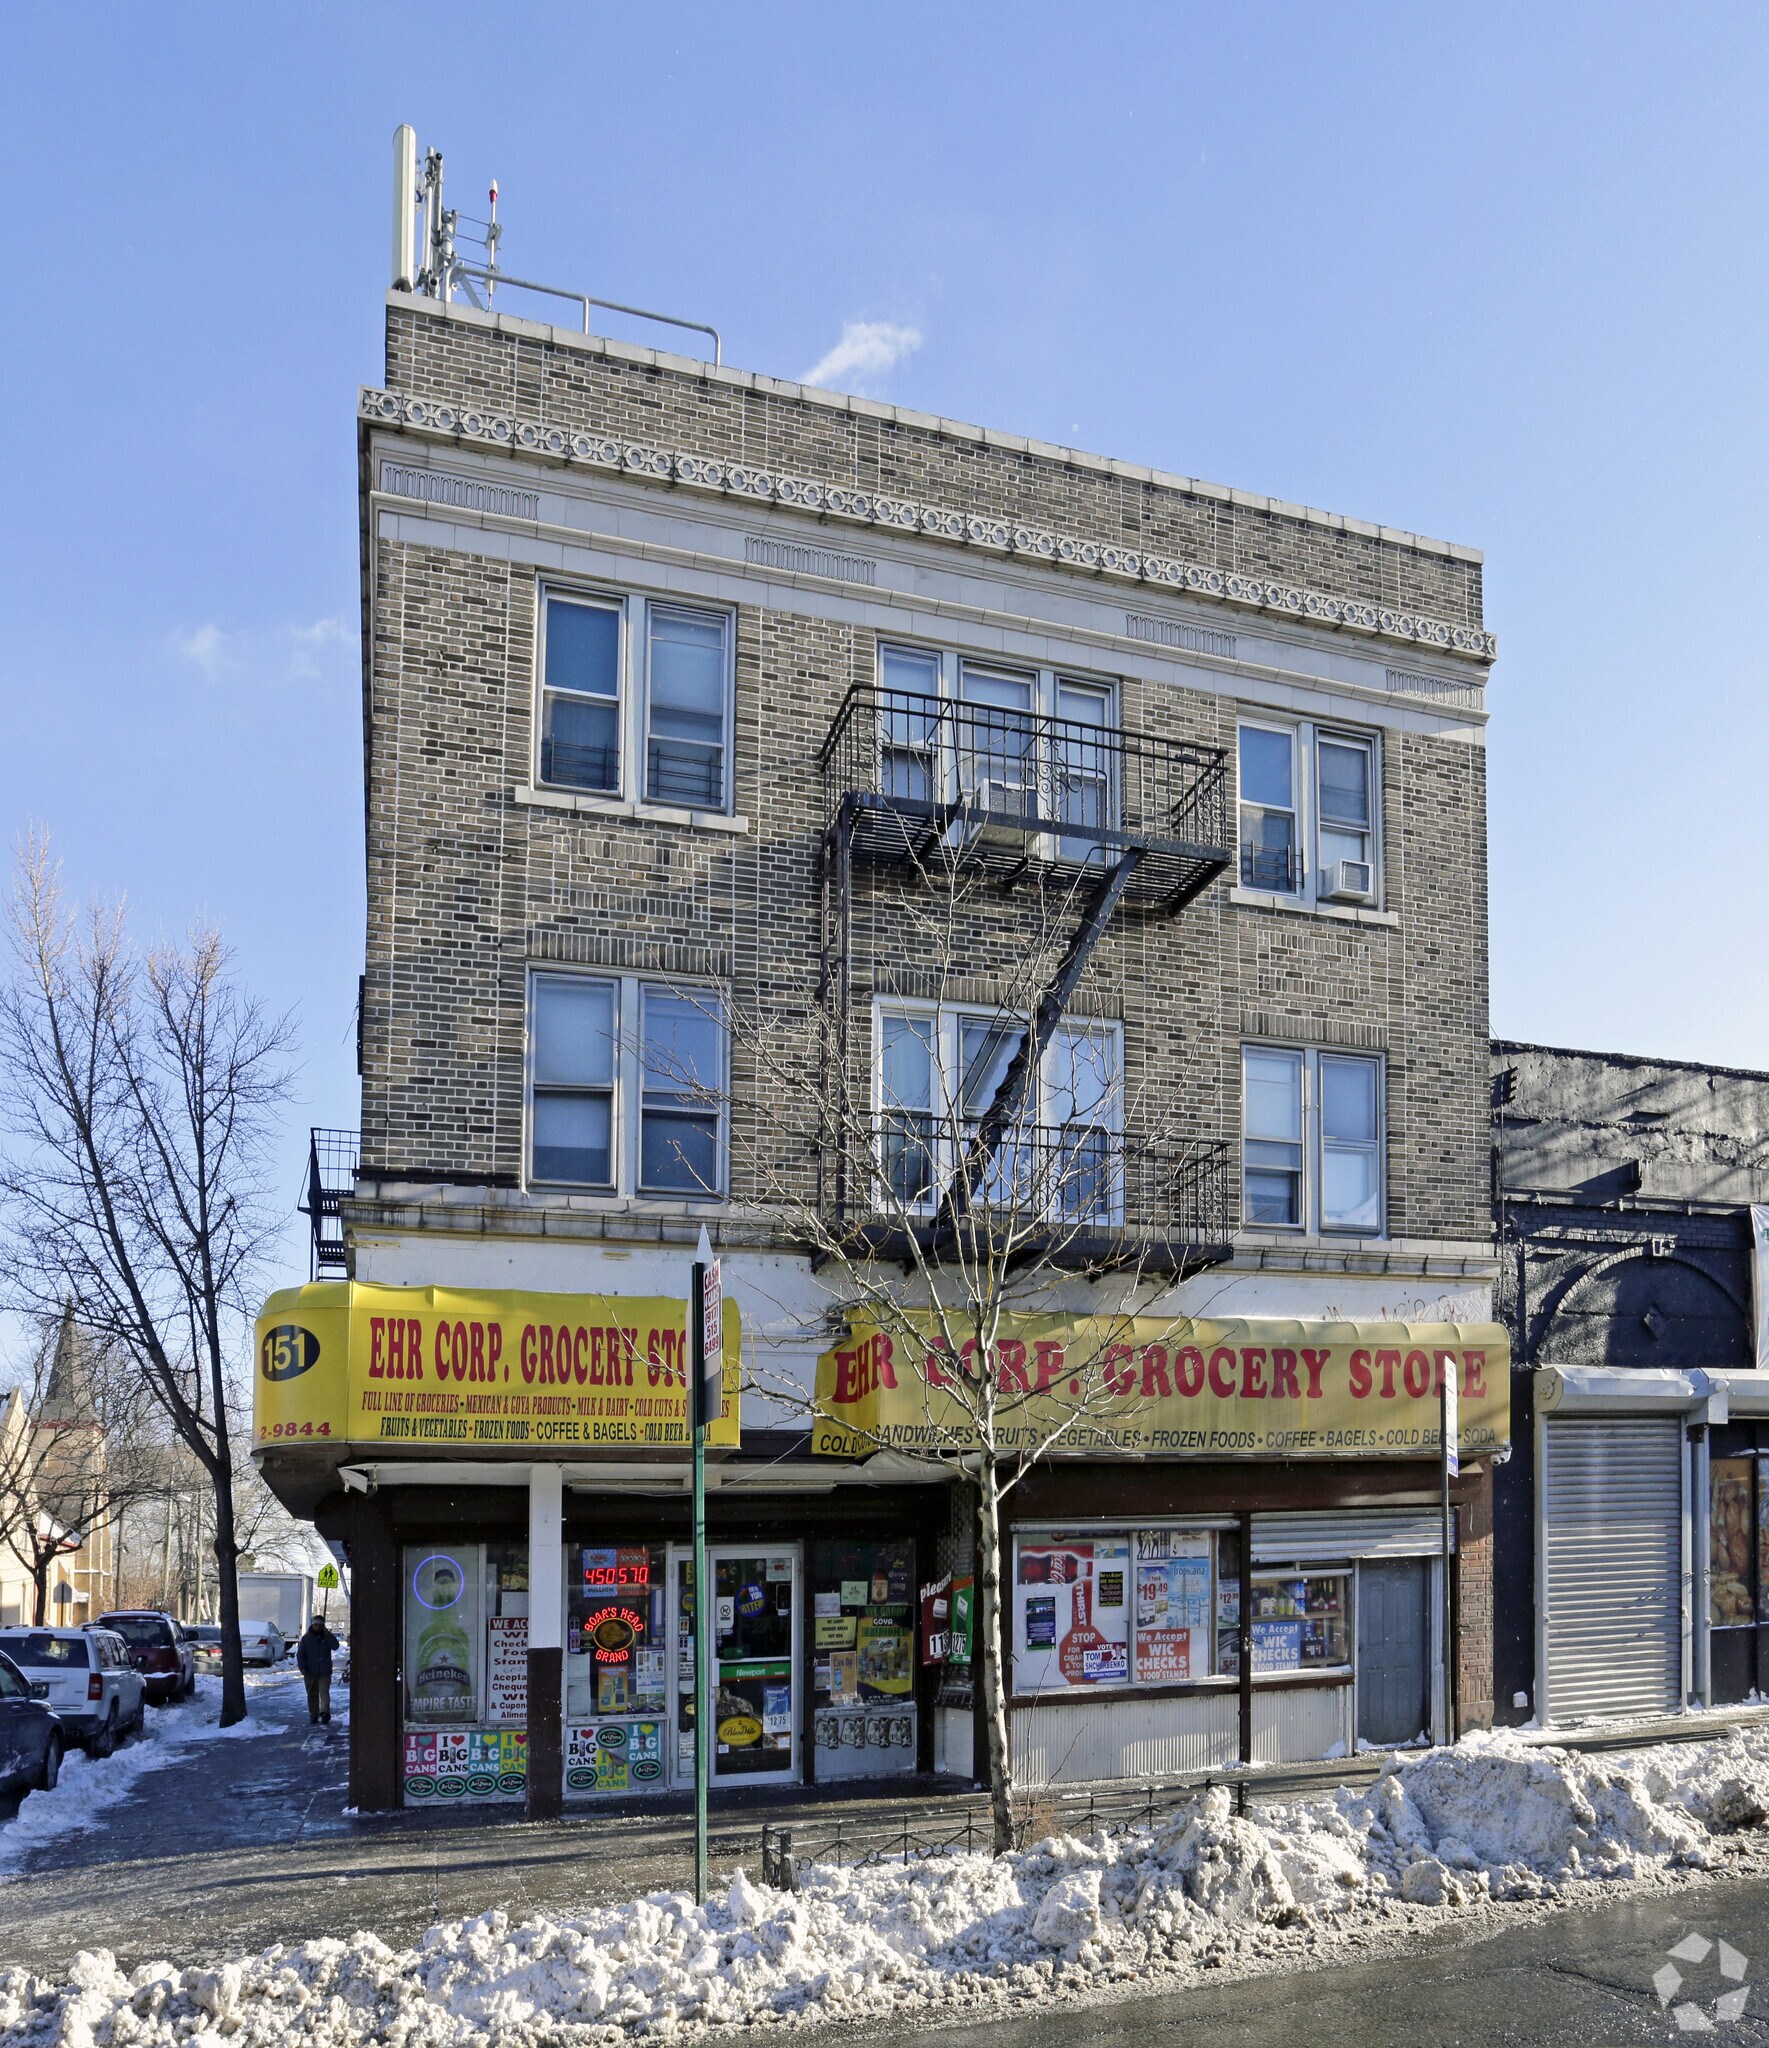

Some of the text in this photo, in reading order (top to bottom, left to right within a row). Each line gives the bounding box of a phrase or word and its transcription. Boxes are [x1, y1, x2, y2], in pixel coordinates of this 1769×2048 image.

[707, 1321, 717, 1339] 515
[265, 1333, 305, 1371] 151
[369, 1317, 422, 1380] EHR
[435, 1320, 509, 1383] CORP.
[521, 1323, 637, 1386] GROCERY
[705, 1335, 718, 1356] 6499
[831, 1333, 898, 1403] EHR
[1103, 1343, 1331, 1399] GROCERY
[362, 1391, 381, 1410] FULL
[384, 1393, 402, 1411] LINE
[404, 1394, 413, 1412] OF
[416, 1394, 458, 1413] GROCERIES
[466, 1395, 502, 1414] MEXICAN
[503, 1397, 508, 1414] &
[510, 1397, 530, 1414] GOYA
[532, 1397, 570, 1416] PRODUCTS
[577, 1399, 597, 1416] MILK
[599, 1399, 604, 1416] &
[606, 1399, 629, 1416] DAIRY
[634, 1400, 653, 1417] COLD
[654, 1400, 672, 1417] CUTS
[674, 1400, 680, 1417] &
[381, 1417, 409, 1437] FRUITS
[412, 1418, 418, 1437] &
[420, 1418, 467, 1438] VEGETABLES
[473, 1420, 504, 1439] FROZEN
[506, 1420, 530, 1440] FOODS
[536, 1422, 579, 1440] COFFEE
[583, 1422, 590, 1440] &
[593, 1422, 636, 1440] BAGELS
[644, 1423, 662, 1441] COLD
[664, 1423, 683, 1441] BEER
[992, 1426, 1037, 1445] RUITS
[1152, 1430, 1206, 1448] FROZEN
[1210, 1431, 1255, 1448] FOODS
[1266, 1431, 1316, 1447] COFFEE
[1326, 1430, 1376, 1446] BAGELS
[1387, 1429, 1418, 1445] COLD
[1464, 1429, 1495, 1444] SODA
[585, 1568, 616, 1584] 450
[618, 1567, 648, 1583] 570
[1173, 1564, 1206, 1577] Tropicana
[493, 1620, 509, 1629] WE
[584, 1607, 644, 1632] BOAR'S HEAD
[873, 1618, 893, 1626] GOYA
[1251, 1624, 1298, 1635] We Accept
[1072, 1633, 1095, 1643] STOP
[1138, 1632, 1187, 1642] We Accept
[1263, 1636, 1287, 1648] WIC
[596, 1649, 629, 1663] GRAND
[1149, 1643, 1174, 1656] WIC
[1251, 1648, 1299, 1661] CHECKS
[1085, 1653, 1100, 1661] TOM
[1137, 1656, 1187, 1670] CHECKS
[1275, 1661, 1299, 1670] STAMPS
[420, 1669, 469, 1684] Heineken
[736, 1668, 765, 1677] Newport
[1143, 1671, 1160, 1679] FOOD
[1162, 1670, 1187, 1679] STAMPS
[568, 1757, 597, 1766] CANS
[629, 1751, 657, 1761] CANS
[406, 1764, 436, 1773] CANS
[438, 1764, 468, 1773] CANS
[470, 1763, 500, 1771] CANS
[598, 1779, 625, 1788] CANS
